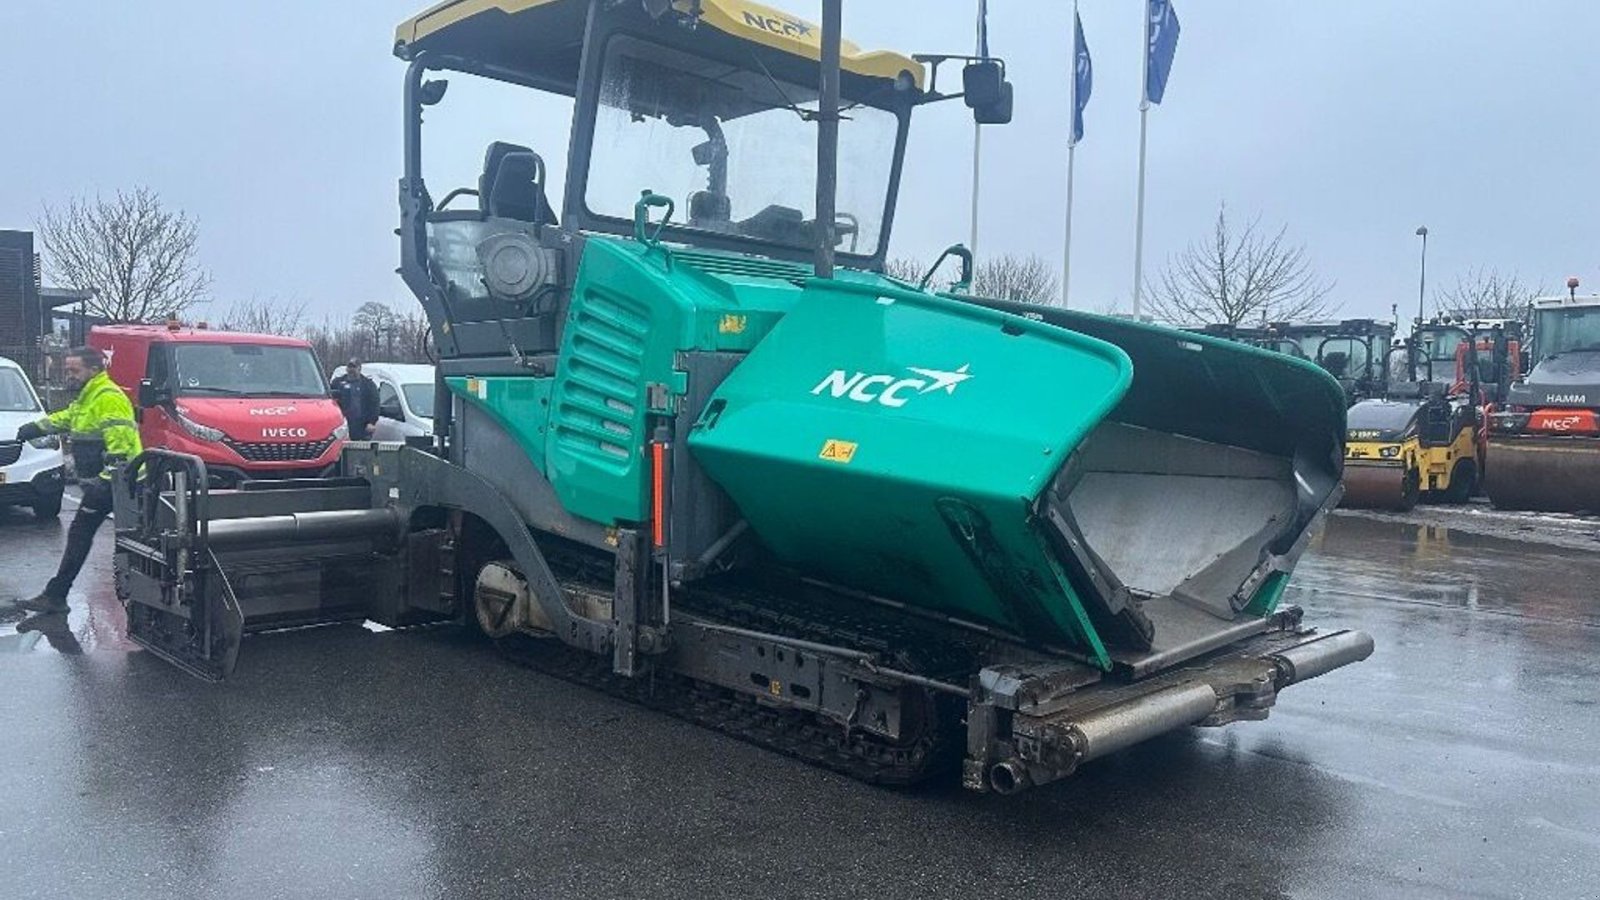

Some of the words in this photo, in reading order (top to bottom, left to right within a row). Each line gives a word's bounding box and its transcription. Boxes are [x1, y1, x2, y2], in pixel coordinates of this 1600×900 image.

[741, 10, 799, 37] NCC
[809, 369, 927, 407] NCC
[1546, 394, 1586, 403] HAMM
[1542, 419, 1571, 430] NCC
[262, 428, 307, 437] IVECO
